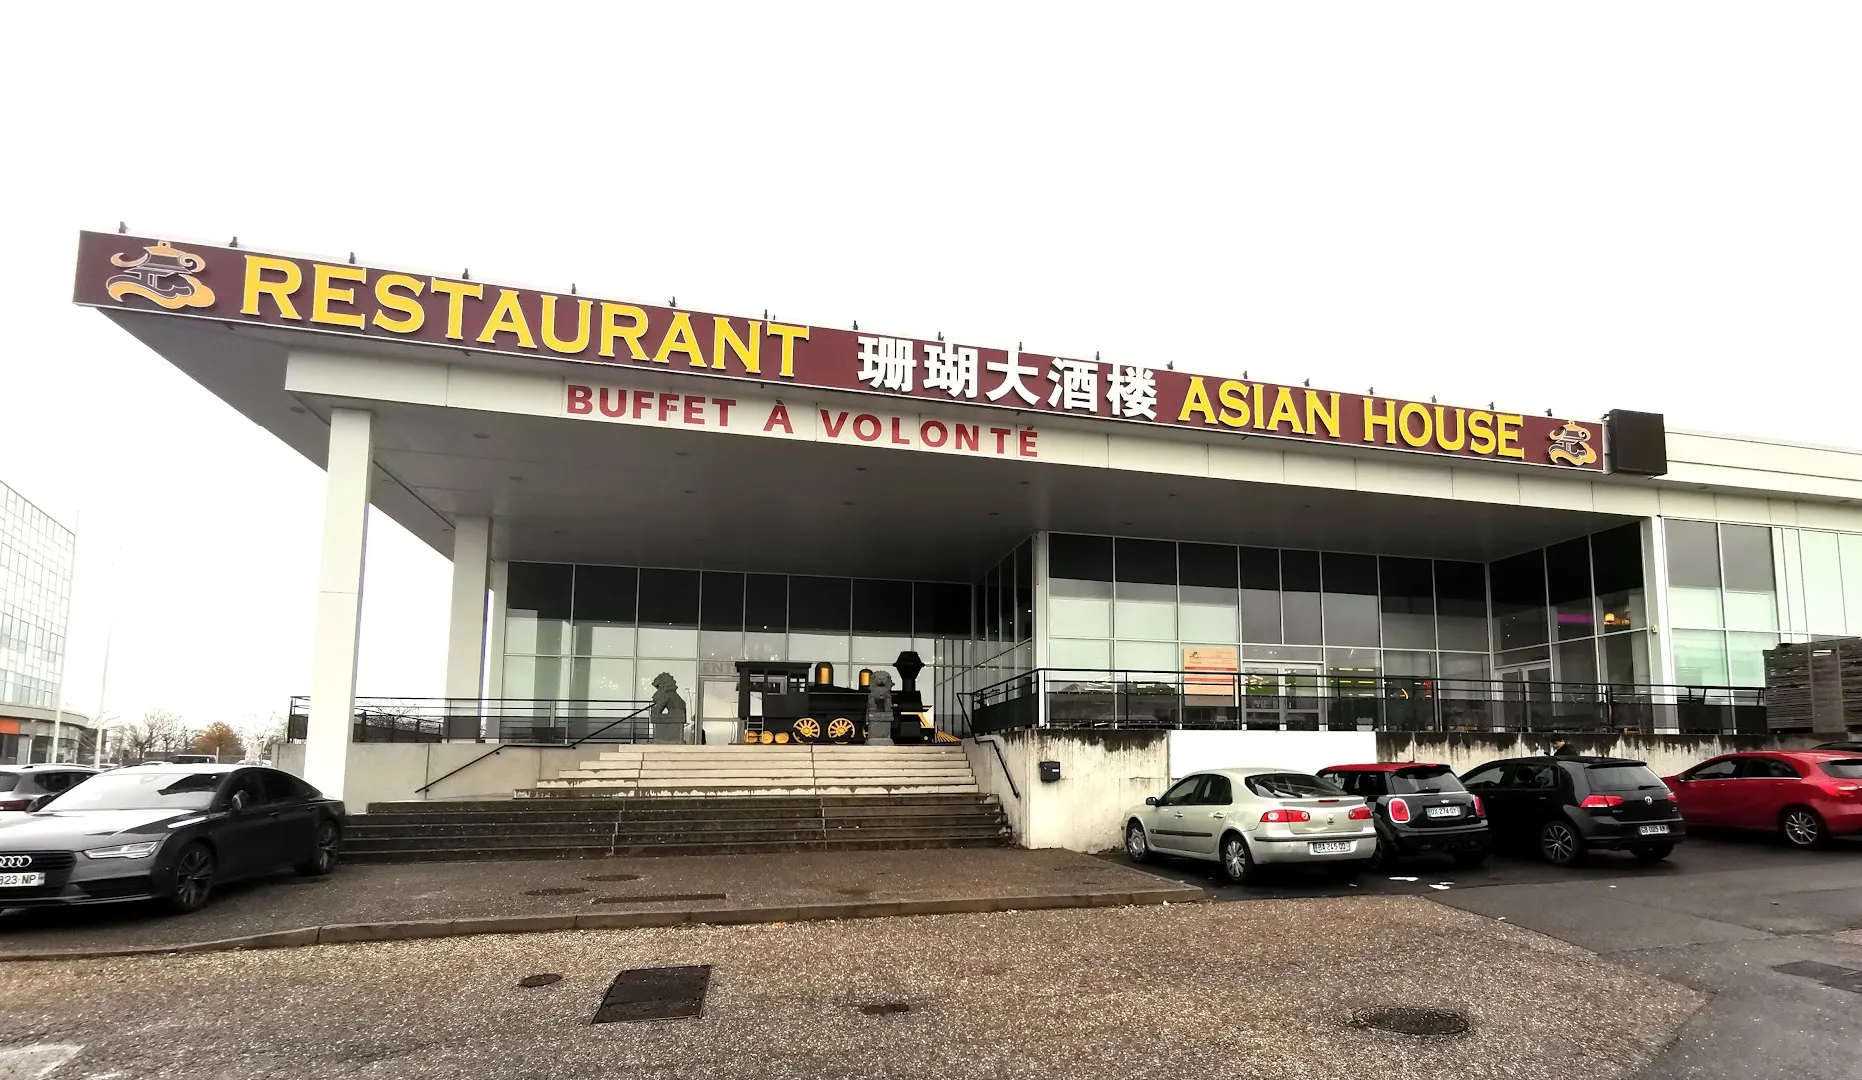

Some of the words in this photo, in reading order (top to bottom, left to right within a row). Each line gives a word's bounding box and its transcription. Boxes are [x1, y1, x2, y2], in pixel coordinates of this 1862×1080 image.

[240, 253, 811, 379] RESTAURANT
[856, 334, 1159, 422] 珊瑚大酒楼
[1177, 375, 1341, 438] ASIAN
[1363, 397, 1525, 459] HOUSE
[566, 384, 737, 427] BUFFET
[762, 399, 795, 435] À
[819, 408, 1039, 459] VOLONTÉ
